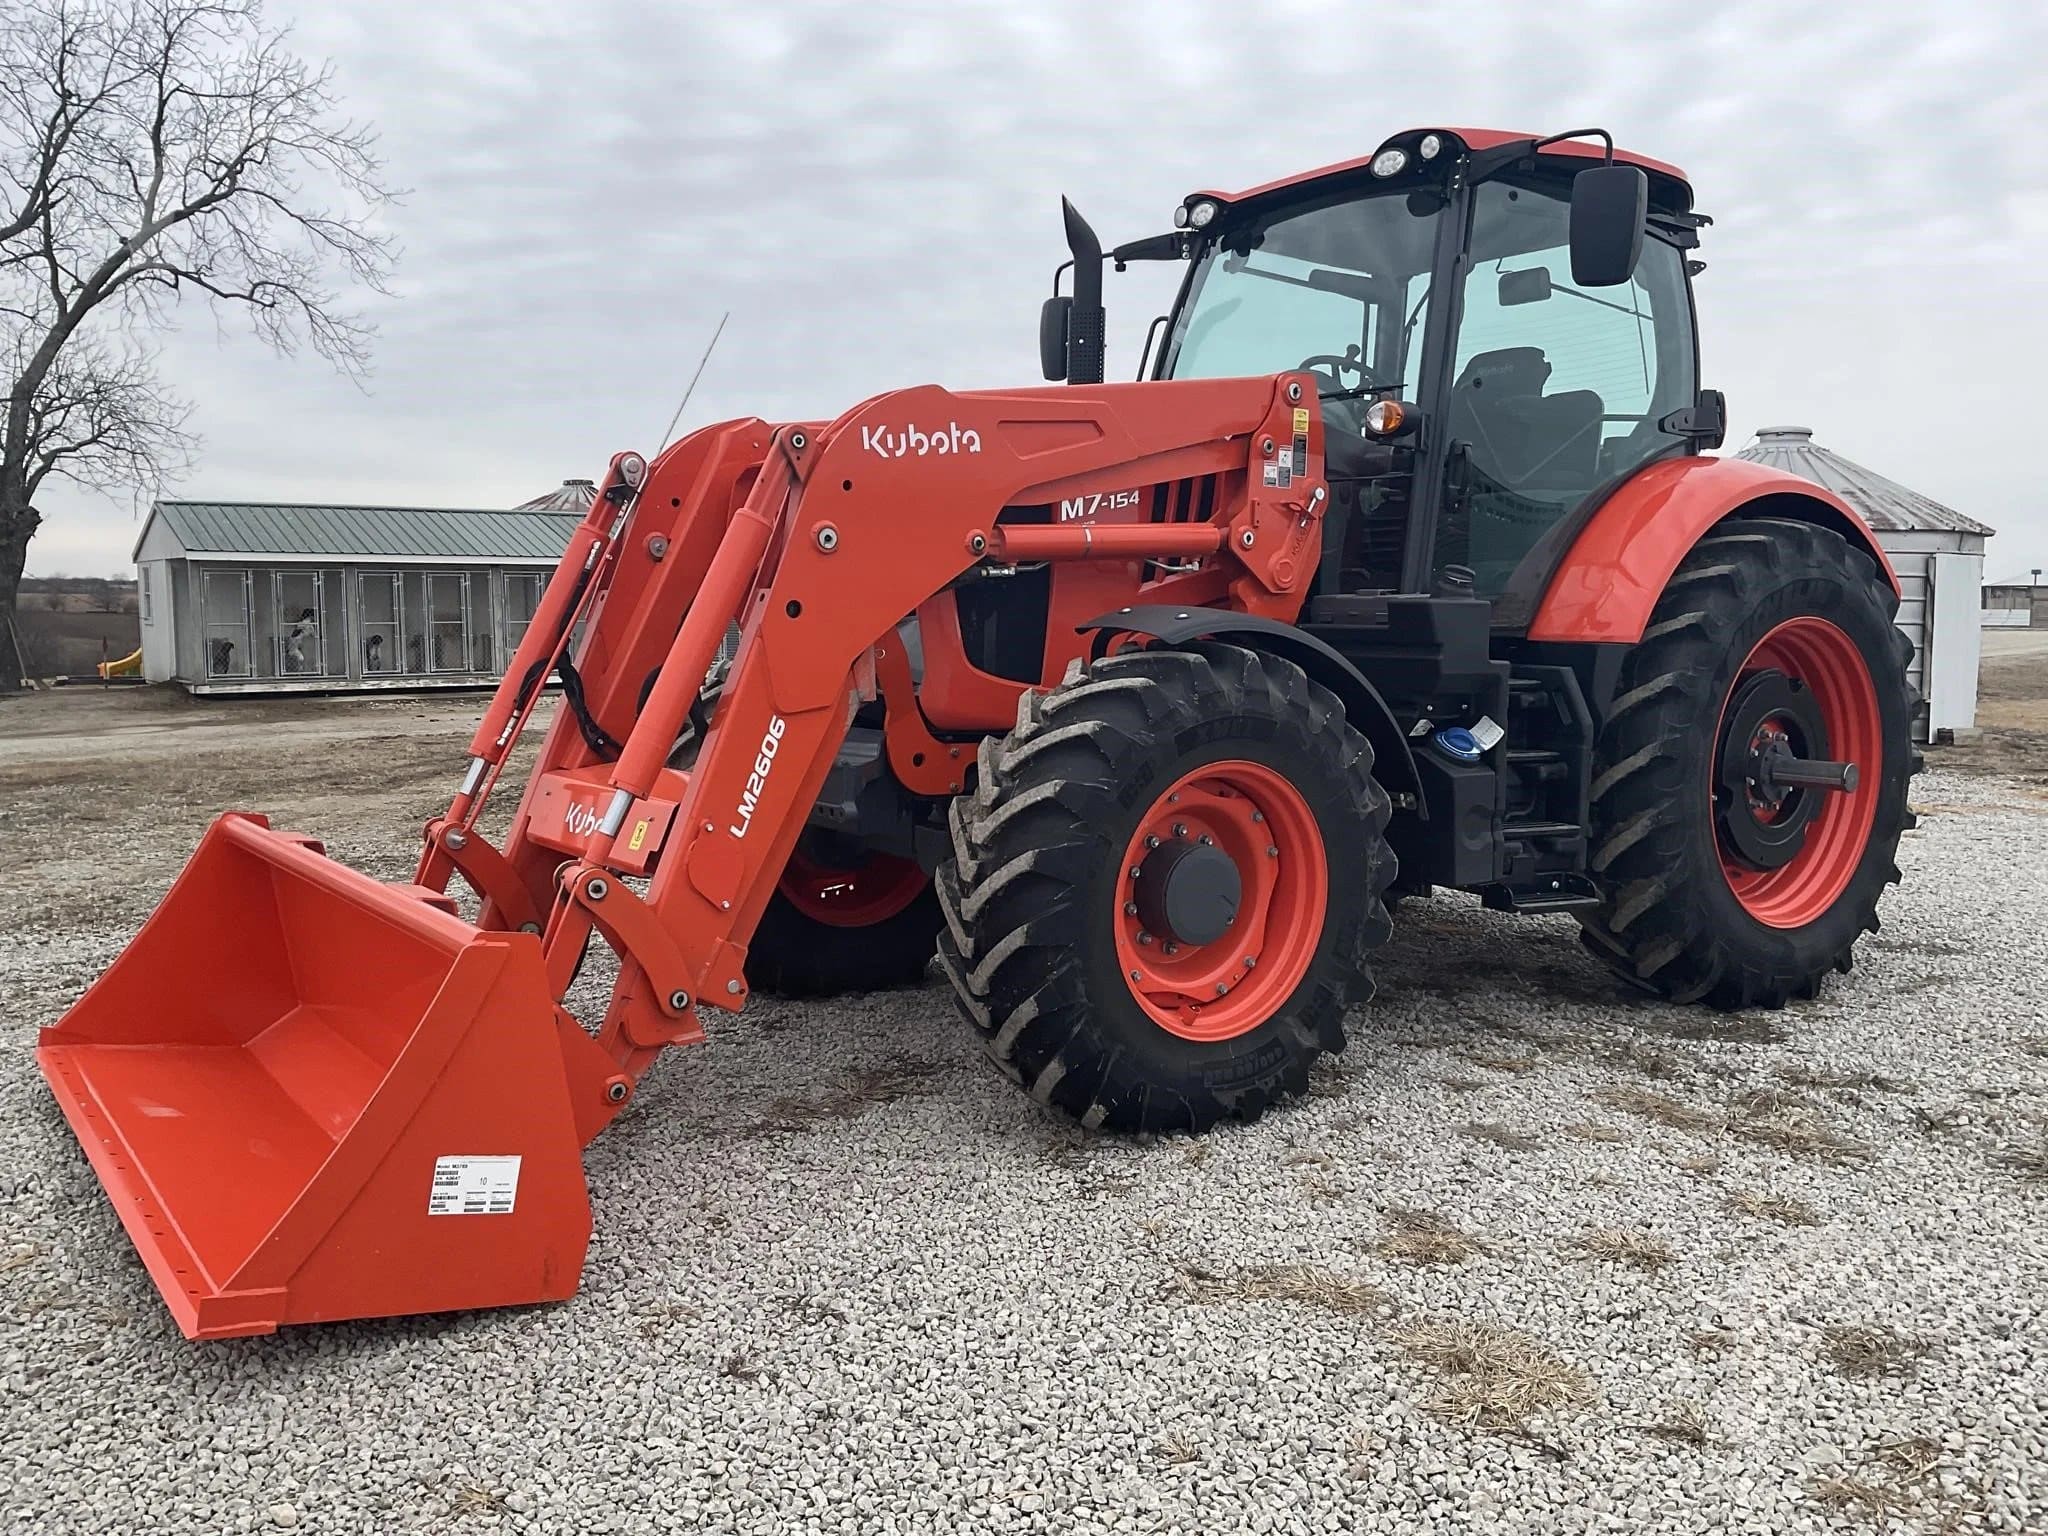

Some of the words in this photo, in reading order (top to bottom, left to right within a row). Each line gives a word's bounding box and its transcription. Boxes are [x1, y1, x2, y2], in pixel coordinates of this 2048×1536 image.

[862, 421, 981, 458] Kubota
[1061, 490, 1140, 521] M7-154
[729, 714, 786, 838] LM2606
